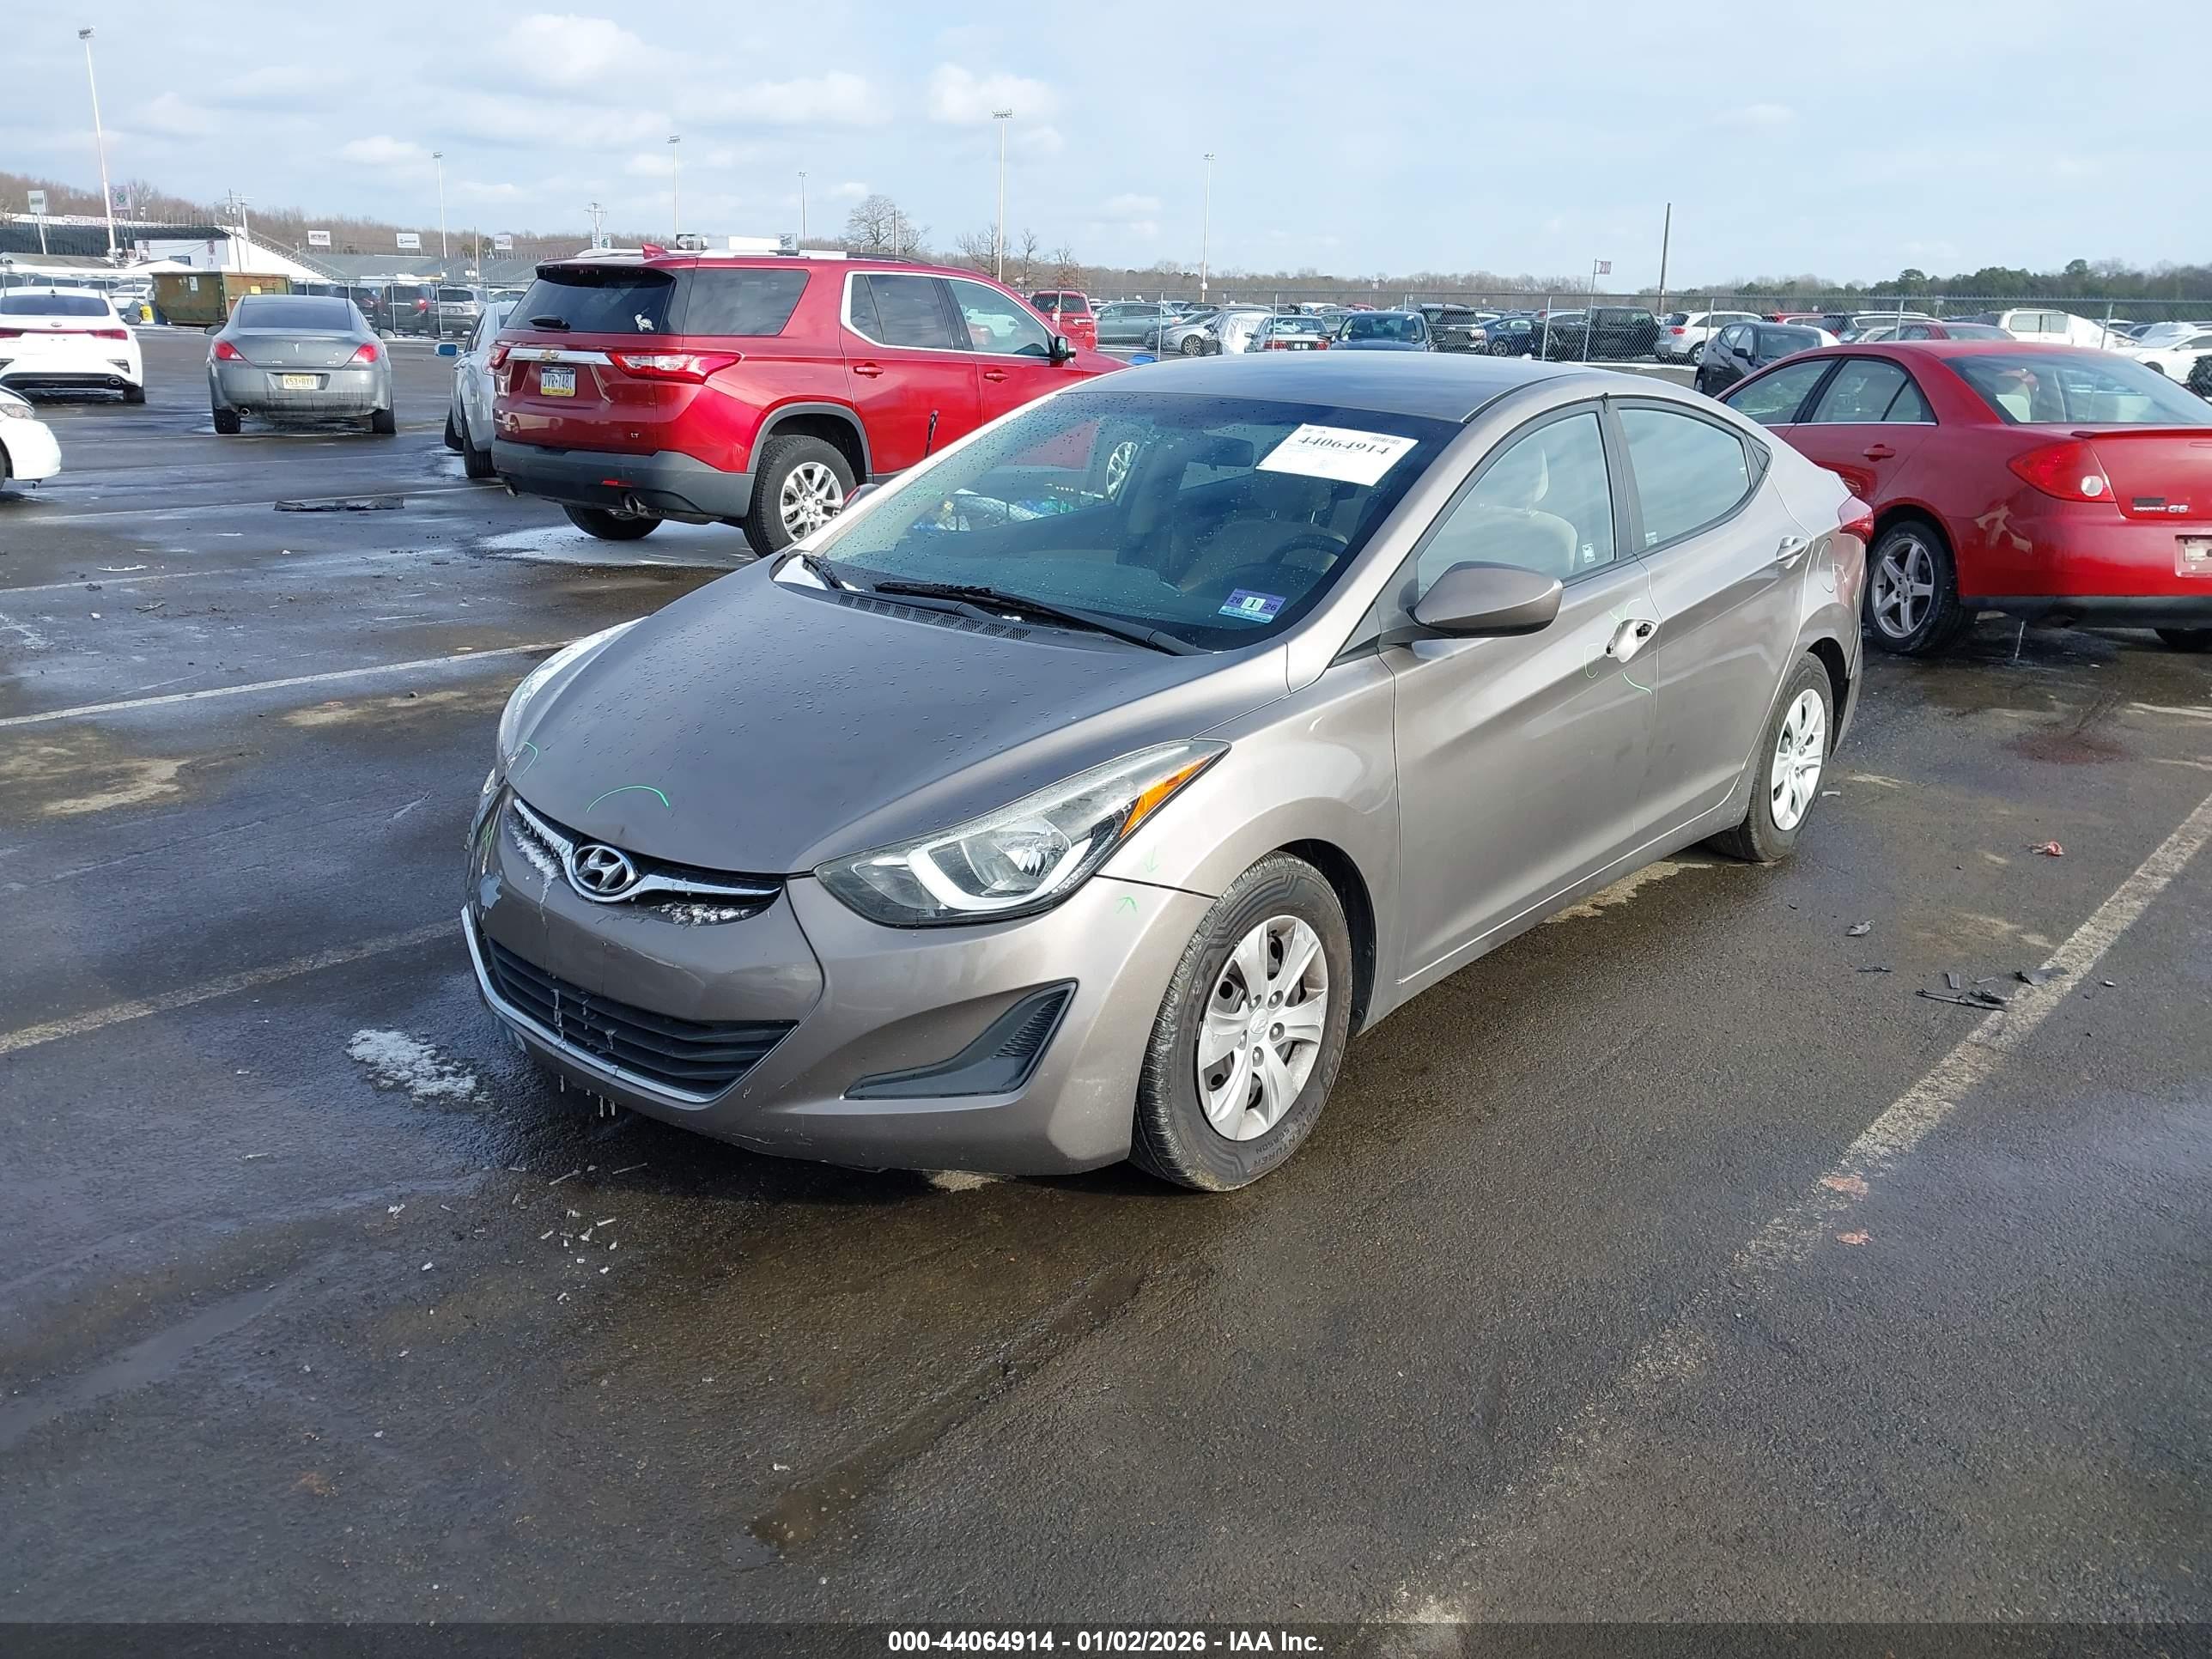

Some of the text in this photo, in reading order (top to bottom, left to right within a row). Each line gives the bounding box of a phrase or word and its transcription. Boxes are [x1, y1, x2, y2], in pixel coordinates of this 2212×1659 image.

[1298, 436, 1391, 455] 44064914
[2167, 504, 2189, 513] G6
[1263, 603, 1278, 611] 26
